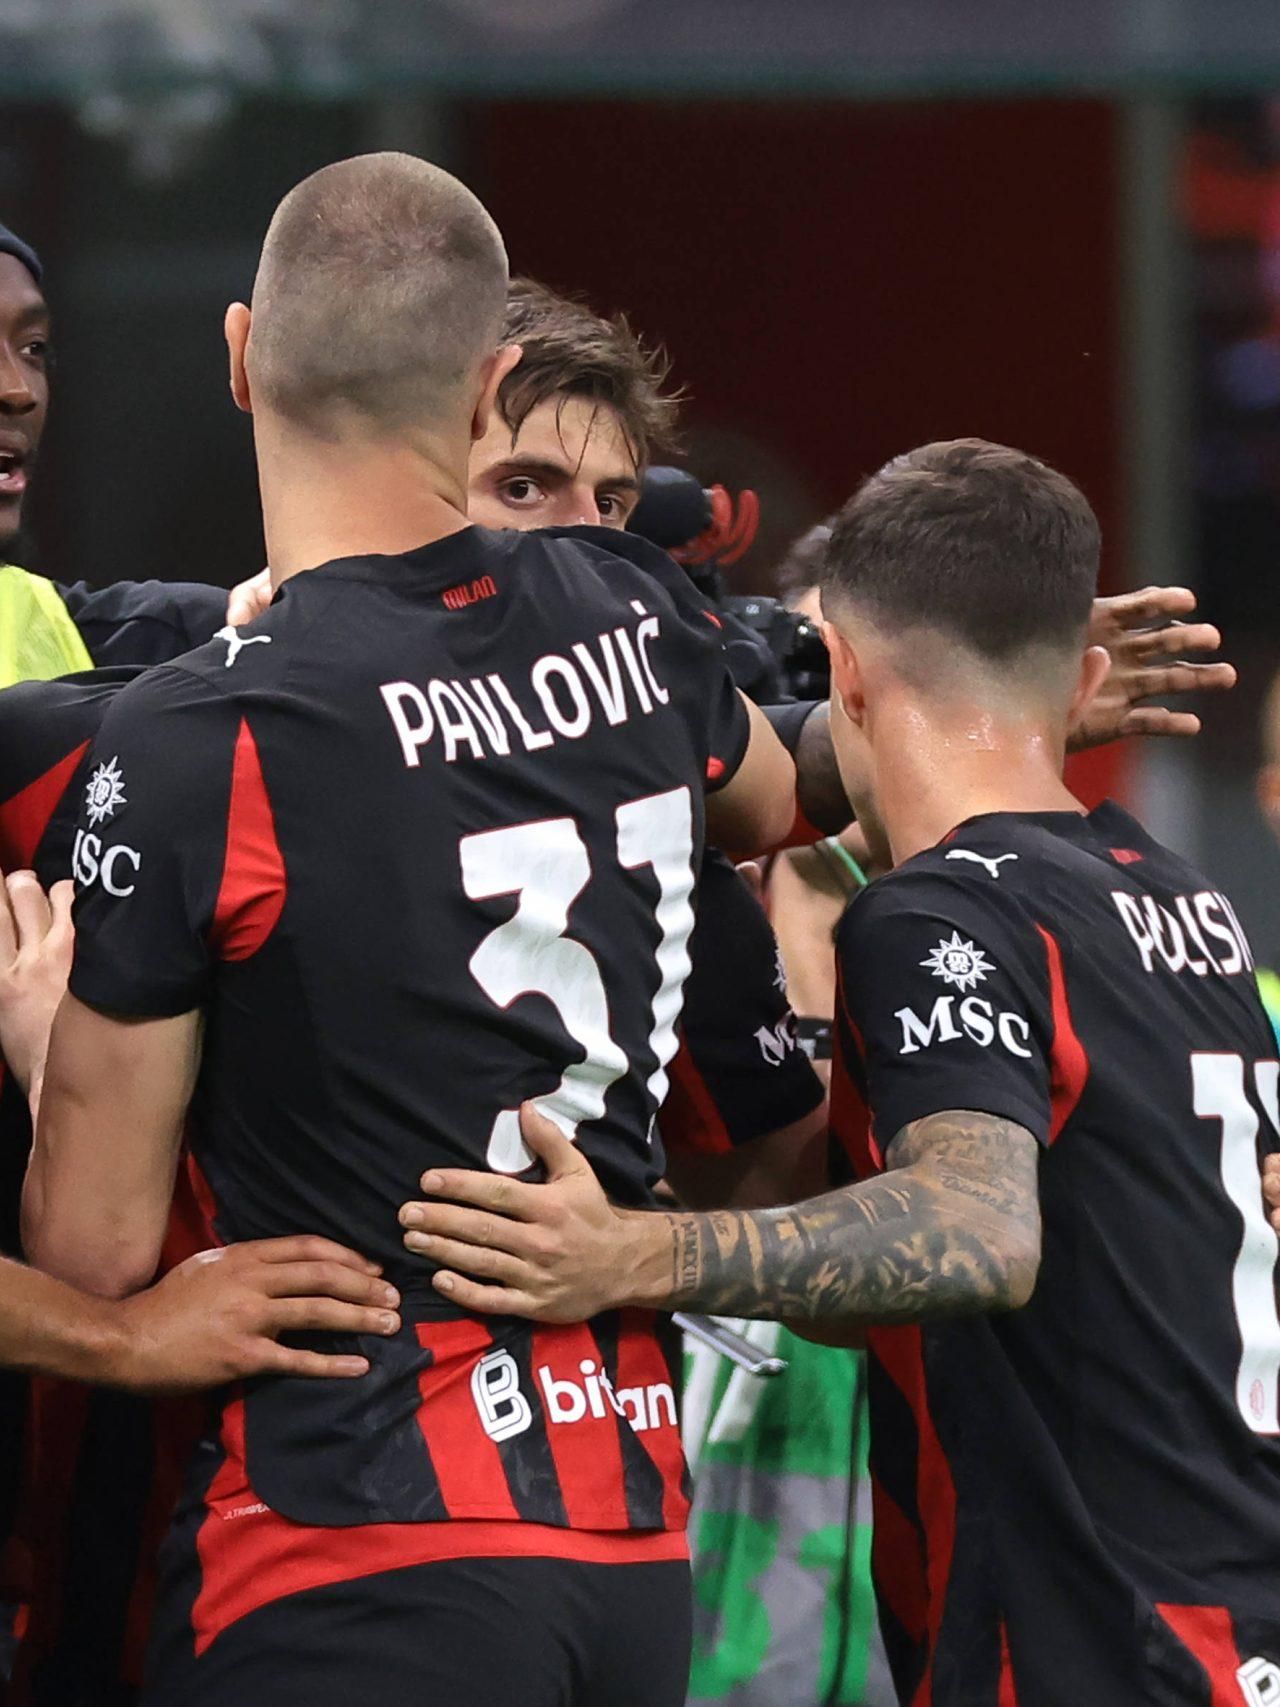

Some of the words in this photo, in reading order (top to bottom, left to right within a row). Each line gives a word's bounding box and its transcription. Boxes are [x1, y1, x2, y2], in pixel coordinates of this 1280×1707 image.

[379, 599, 669, 768] PAVLOVIĆ
[72, 828, 141, 897] SC
[459, 785, 695, 1174] 31
[894, 995, 1033, 1058] MSC
